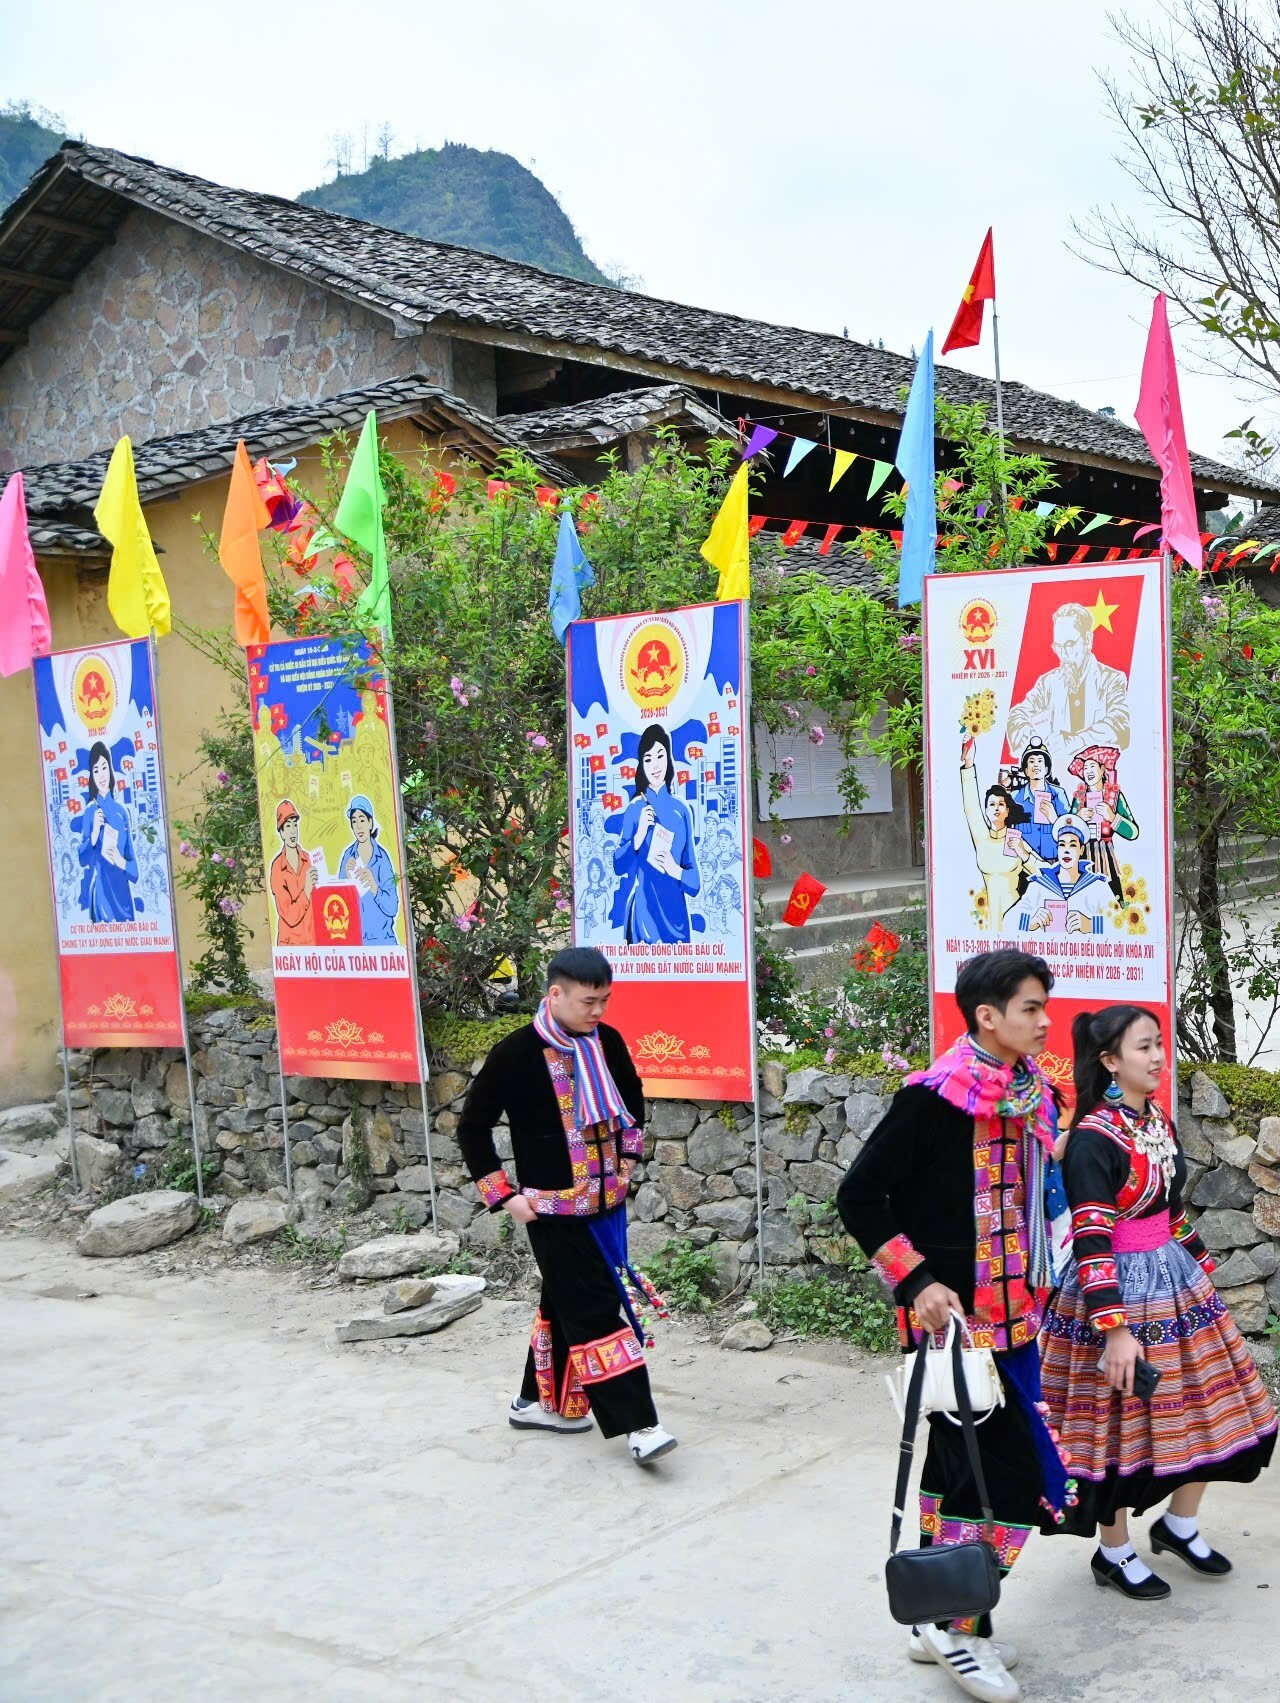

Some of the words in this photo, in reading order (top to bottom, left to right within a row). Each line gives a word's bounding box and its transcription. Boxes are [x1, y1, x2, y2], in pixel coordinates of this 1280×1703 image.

[964, 648, 995, 670] XVI
[946, 936, 961, 952] NGÀY
[1022, 937, 1038, 955] NƯỚC
[1039, 941, 1045, 955] ĐI
[1047, 937, 1058, 956] BẦU
[1060, 936, 1068, 956] CỬ
[1070, 942, 1079, 959] ĐẠI
[1081, 937, 1094, 957] BIỂU
[1096, 938, 1112, 958] QUỐC
[1114, 941, 1124, 961] HỘI
[1126, 941, 1142, 958] KHÓA
[1144, 945, 1154, 958] XVI
[275, 953, 301, 971] NGÀY
[305, 953, 322, 975] HỘI
[325, 949, 346, 971] CỦA
[348, 953, 377, 971] TOÀN
[381, 952, 406, 971] DÂN
[1062, 959, 1073, 978] CẤP
[1076, 962, 1095, 982] NHIỆM
[1096, 963, 1104, 979] KỲ
[1106, 966, 1120, 979] 2026
[1126, 967, 1143, 980] 2031!
